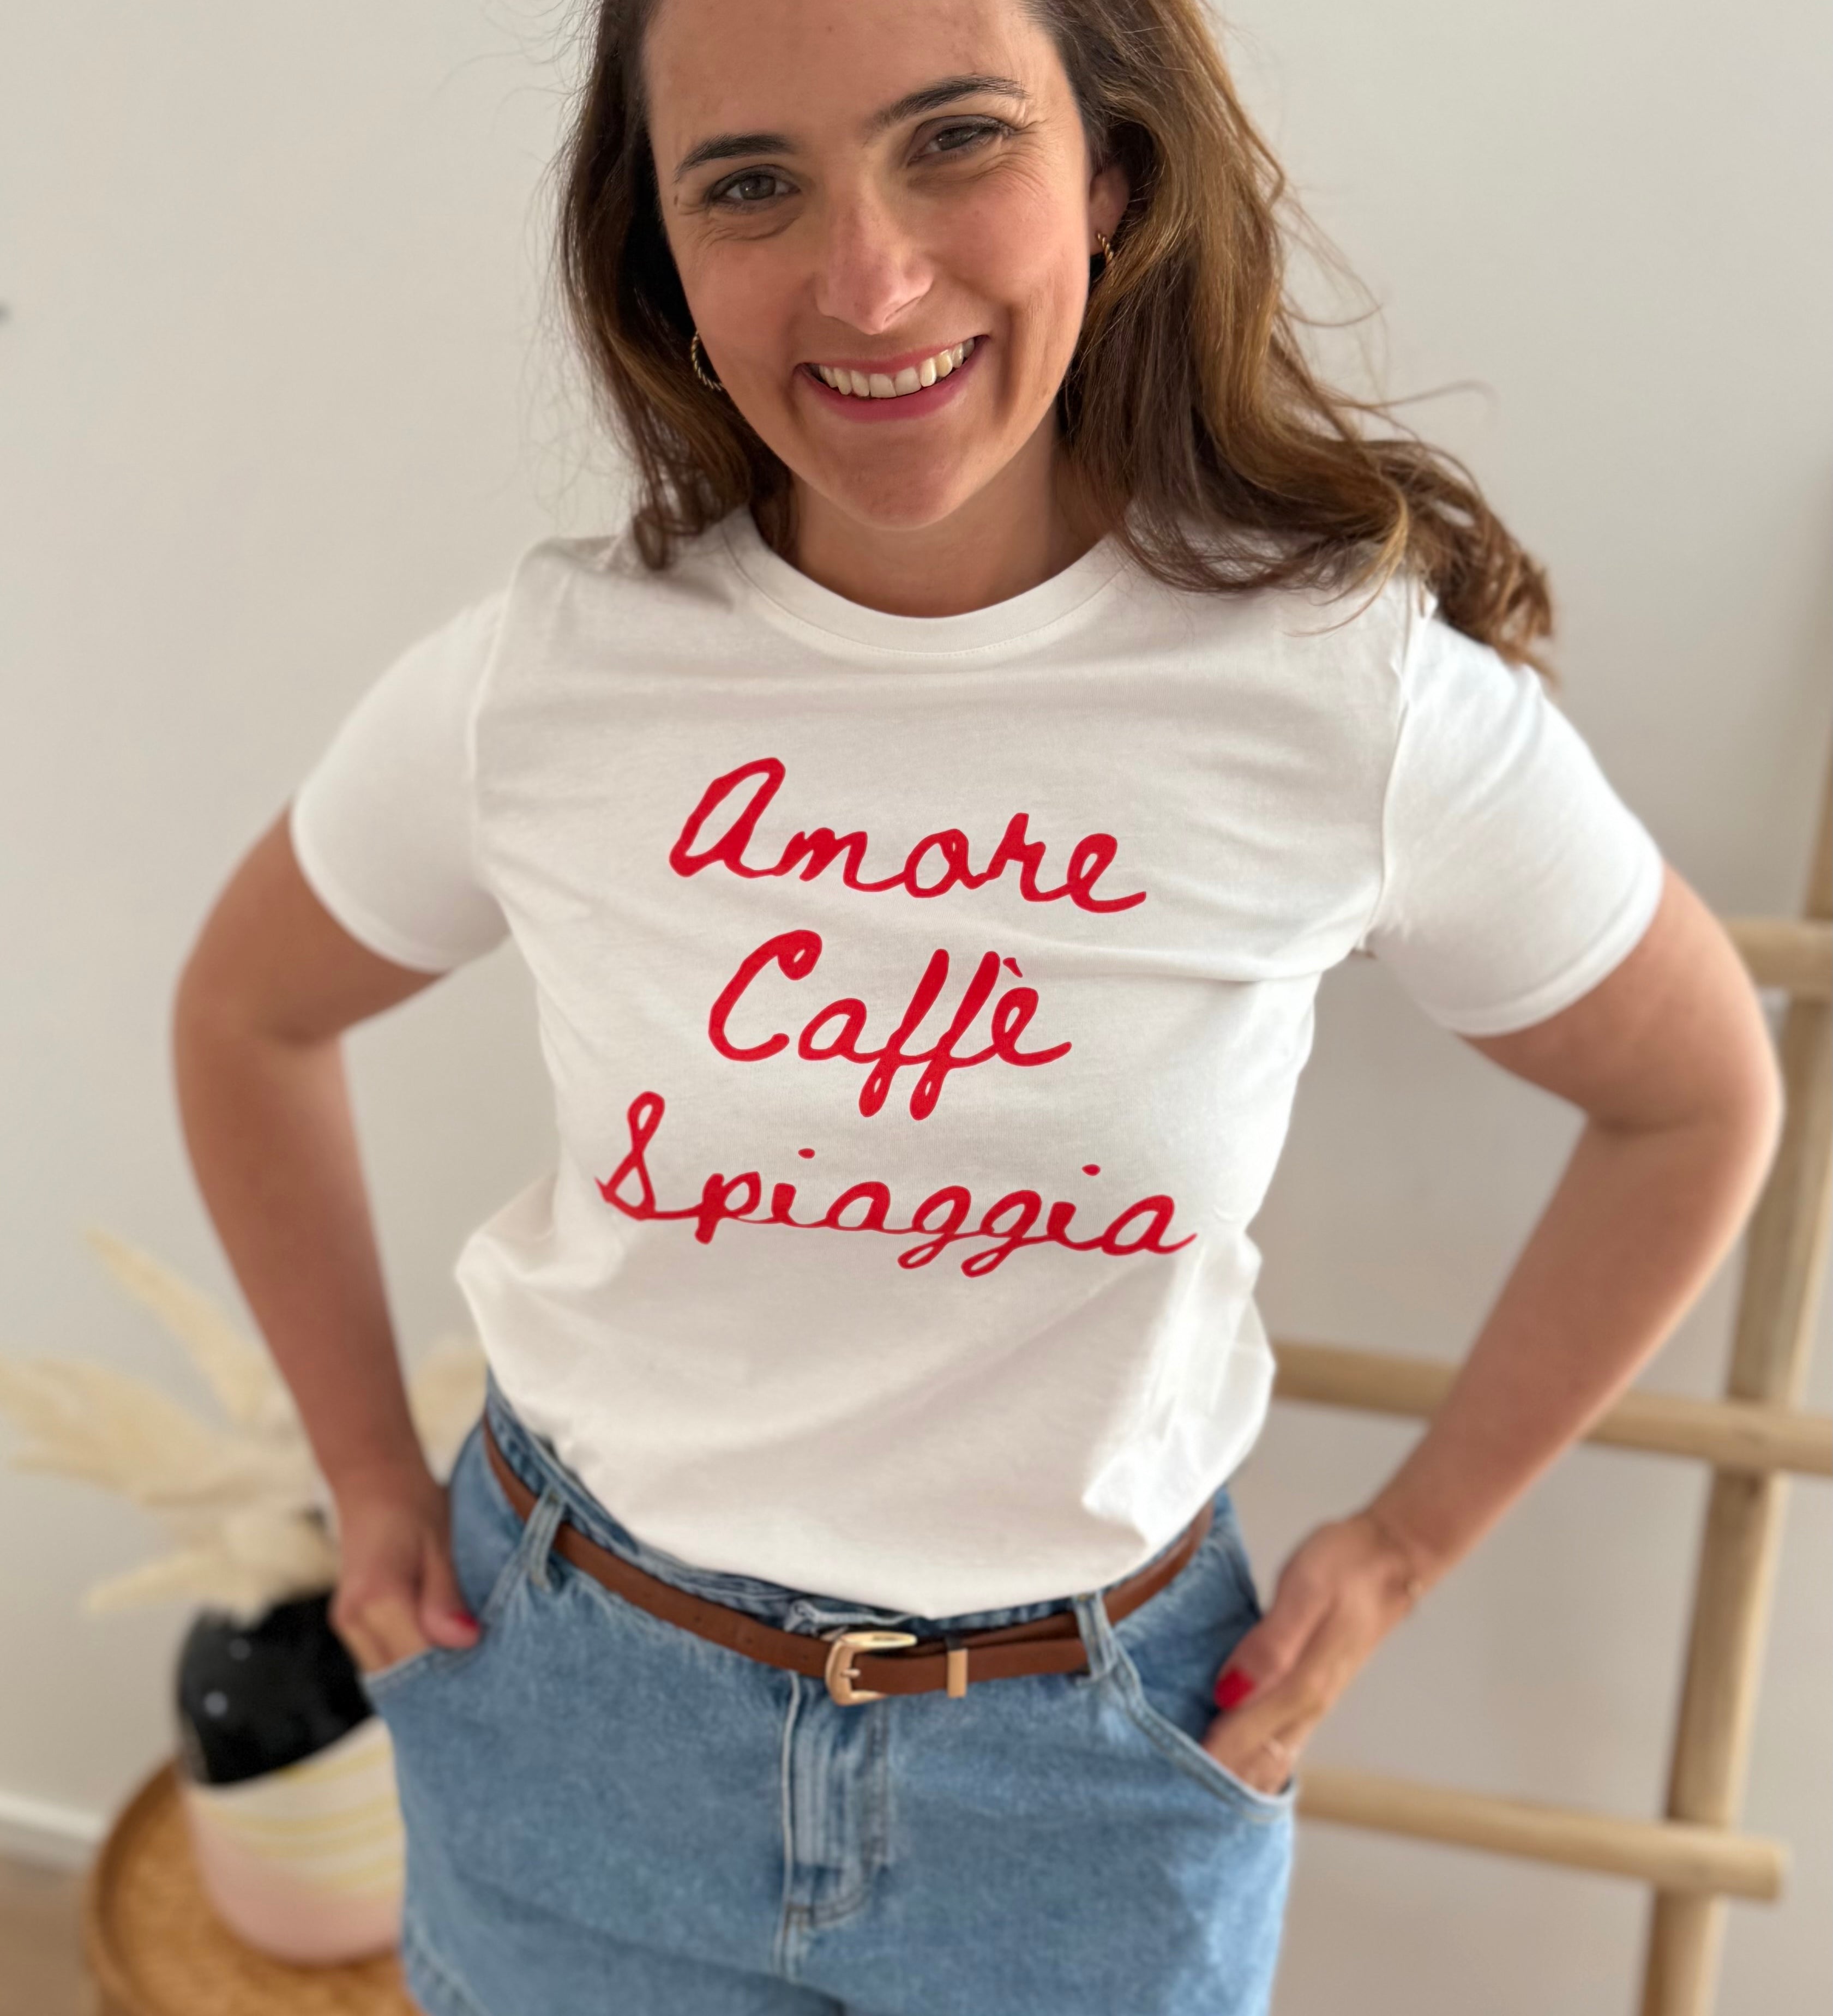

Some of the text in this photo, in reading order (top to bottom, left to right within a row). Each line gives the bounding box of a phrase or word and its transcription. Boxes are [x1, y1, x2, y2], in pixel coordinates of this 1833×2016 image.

[669, 757, 1146, 913] Amore
[708, 929, 1072, 1121] Caffè
[595, 1091, 1197, 1278] Spiaggia
